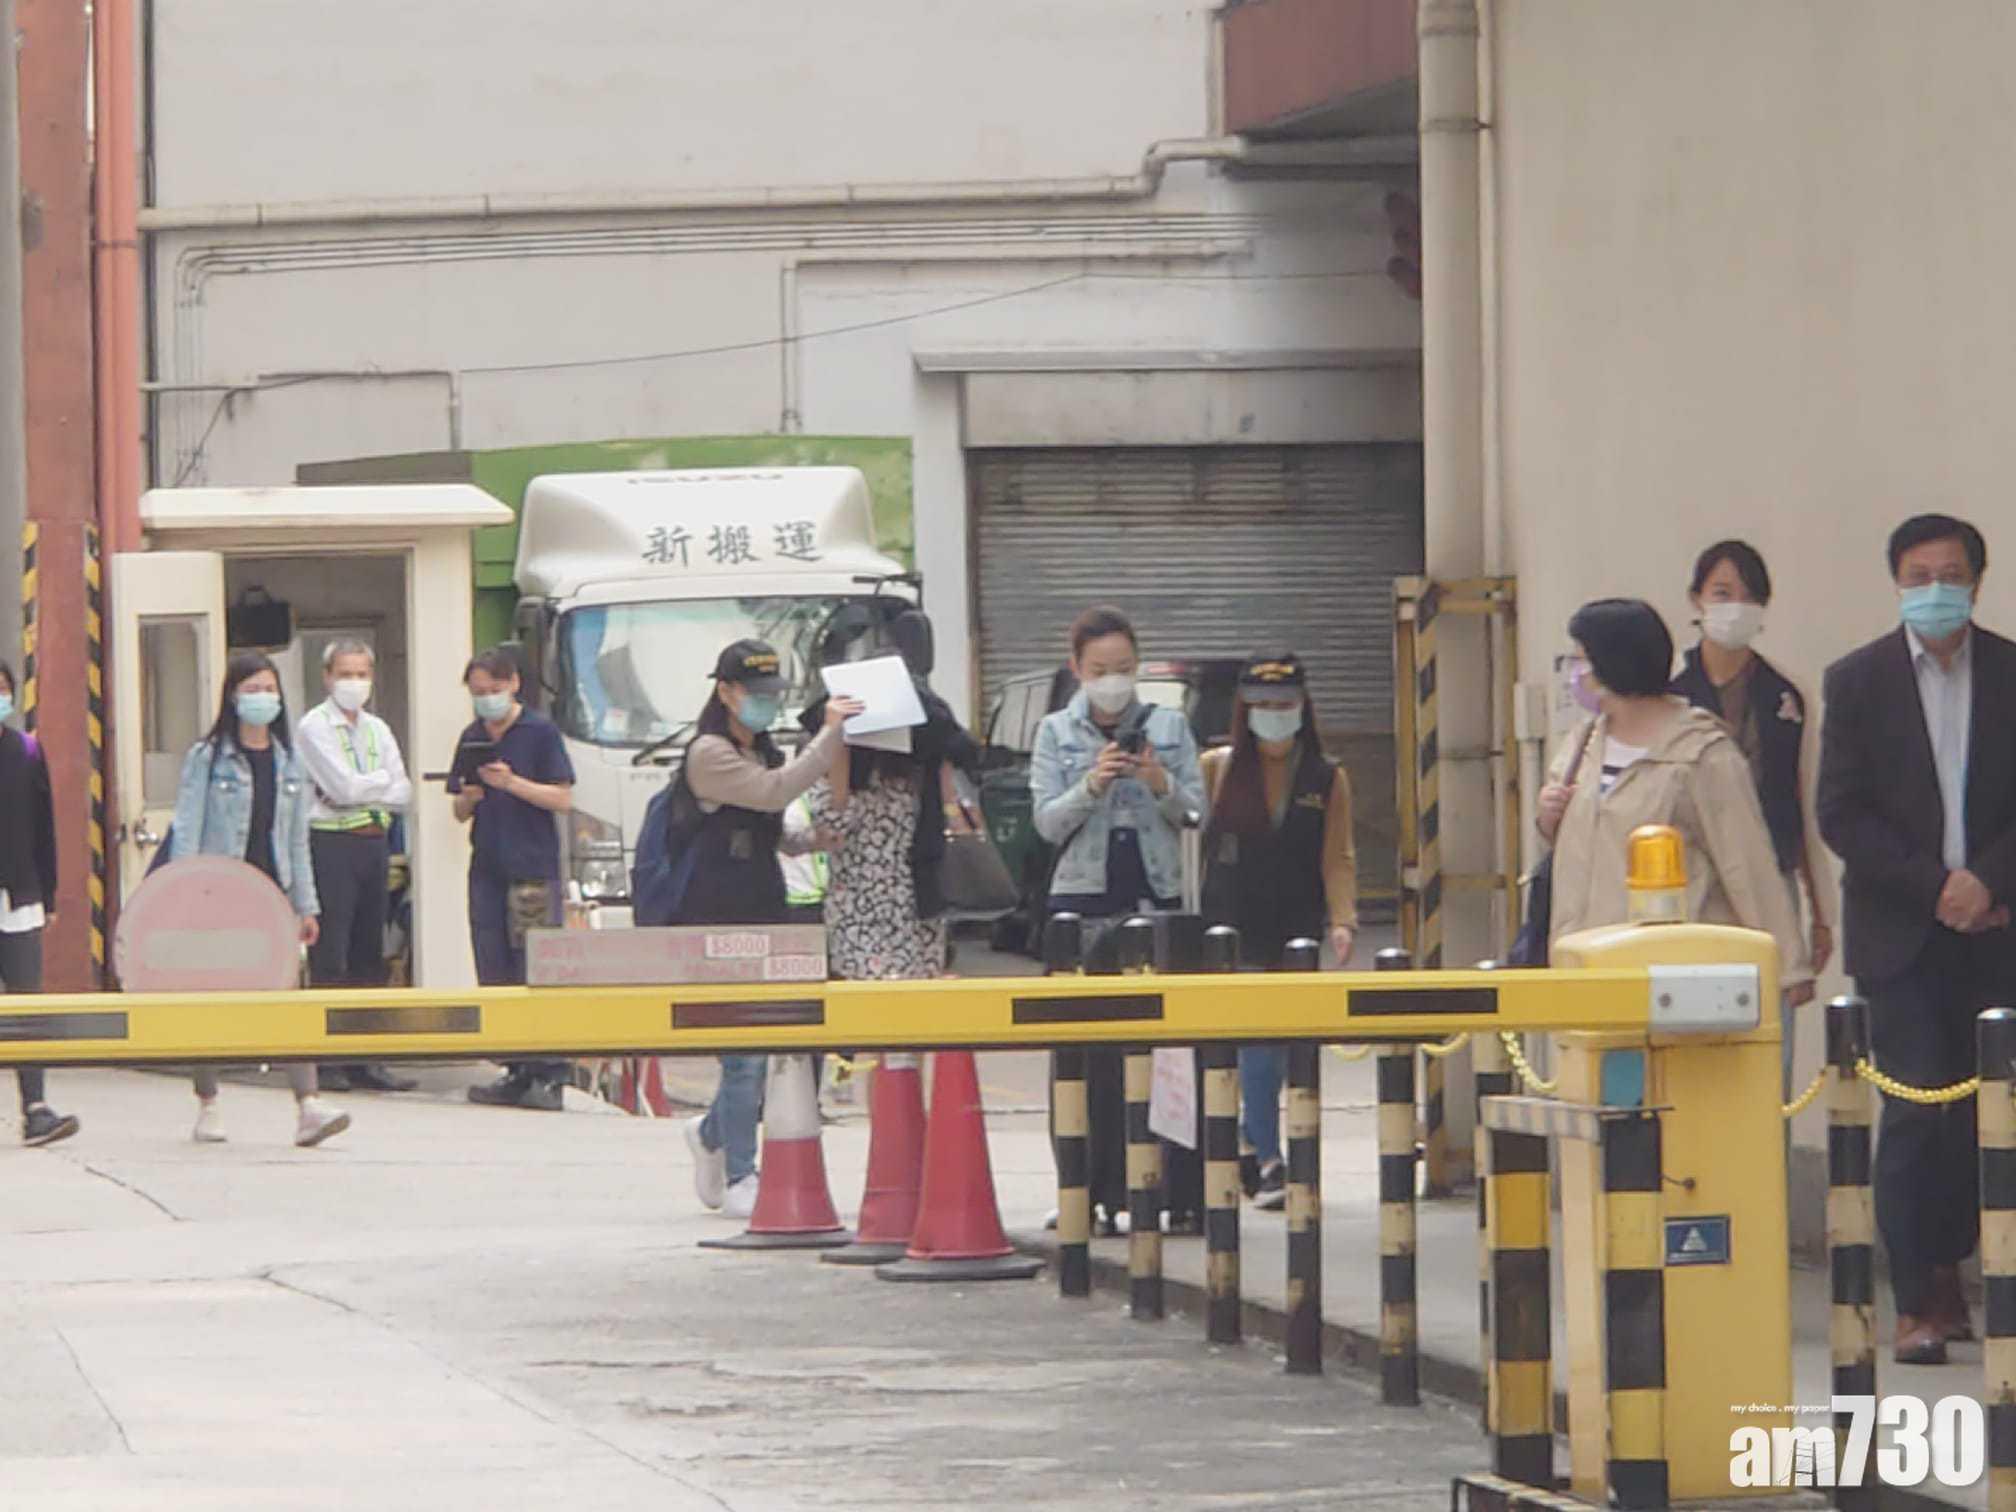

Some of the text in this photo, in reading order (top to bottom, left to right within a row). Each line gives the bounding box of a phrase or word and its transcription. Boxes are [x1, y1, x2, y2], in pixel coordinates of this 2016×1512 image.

[641, 520, 823, 567] 新搬運
[711, 935, 766, 955] $8000
[769, 957, 824, 977] $8000
